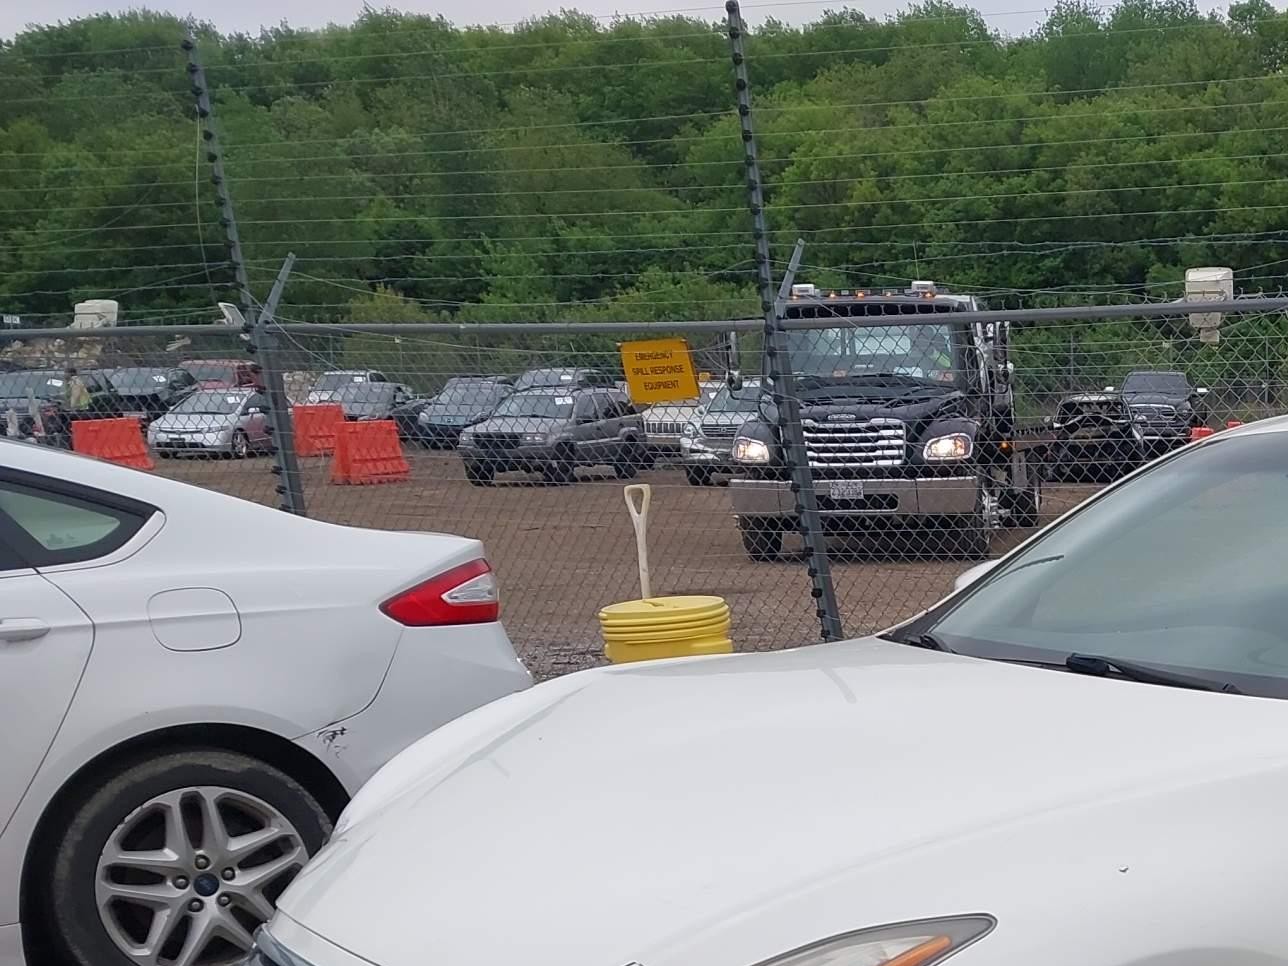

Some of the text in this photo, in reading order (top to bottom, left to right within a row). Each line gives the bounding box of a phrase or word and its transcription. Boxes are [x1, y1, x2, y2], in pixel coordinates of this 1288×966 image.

[634, 350, 673, 361] EMERGENCY
[632, 364, 685, 376] SPILL RESPONSE
[643, 380, 680, 391] EQUIPMENT
